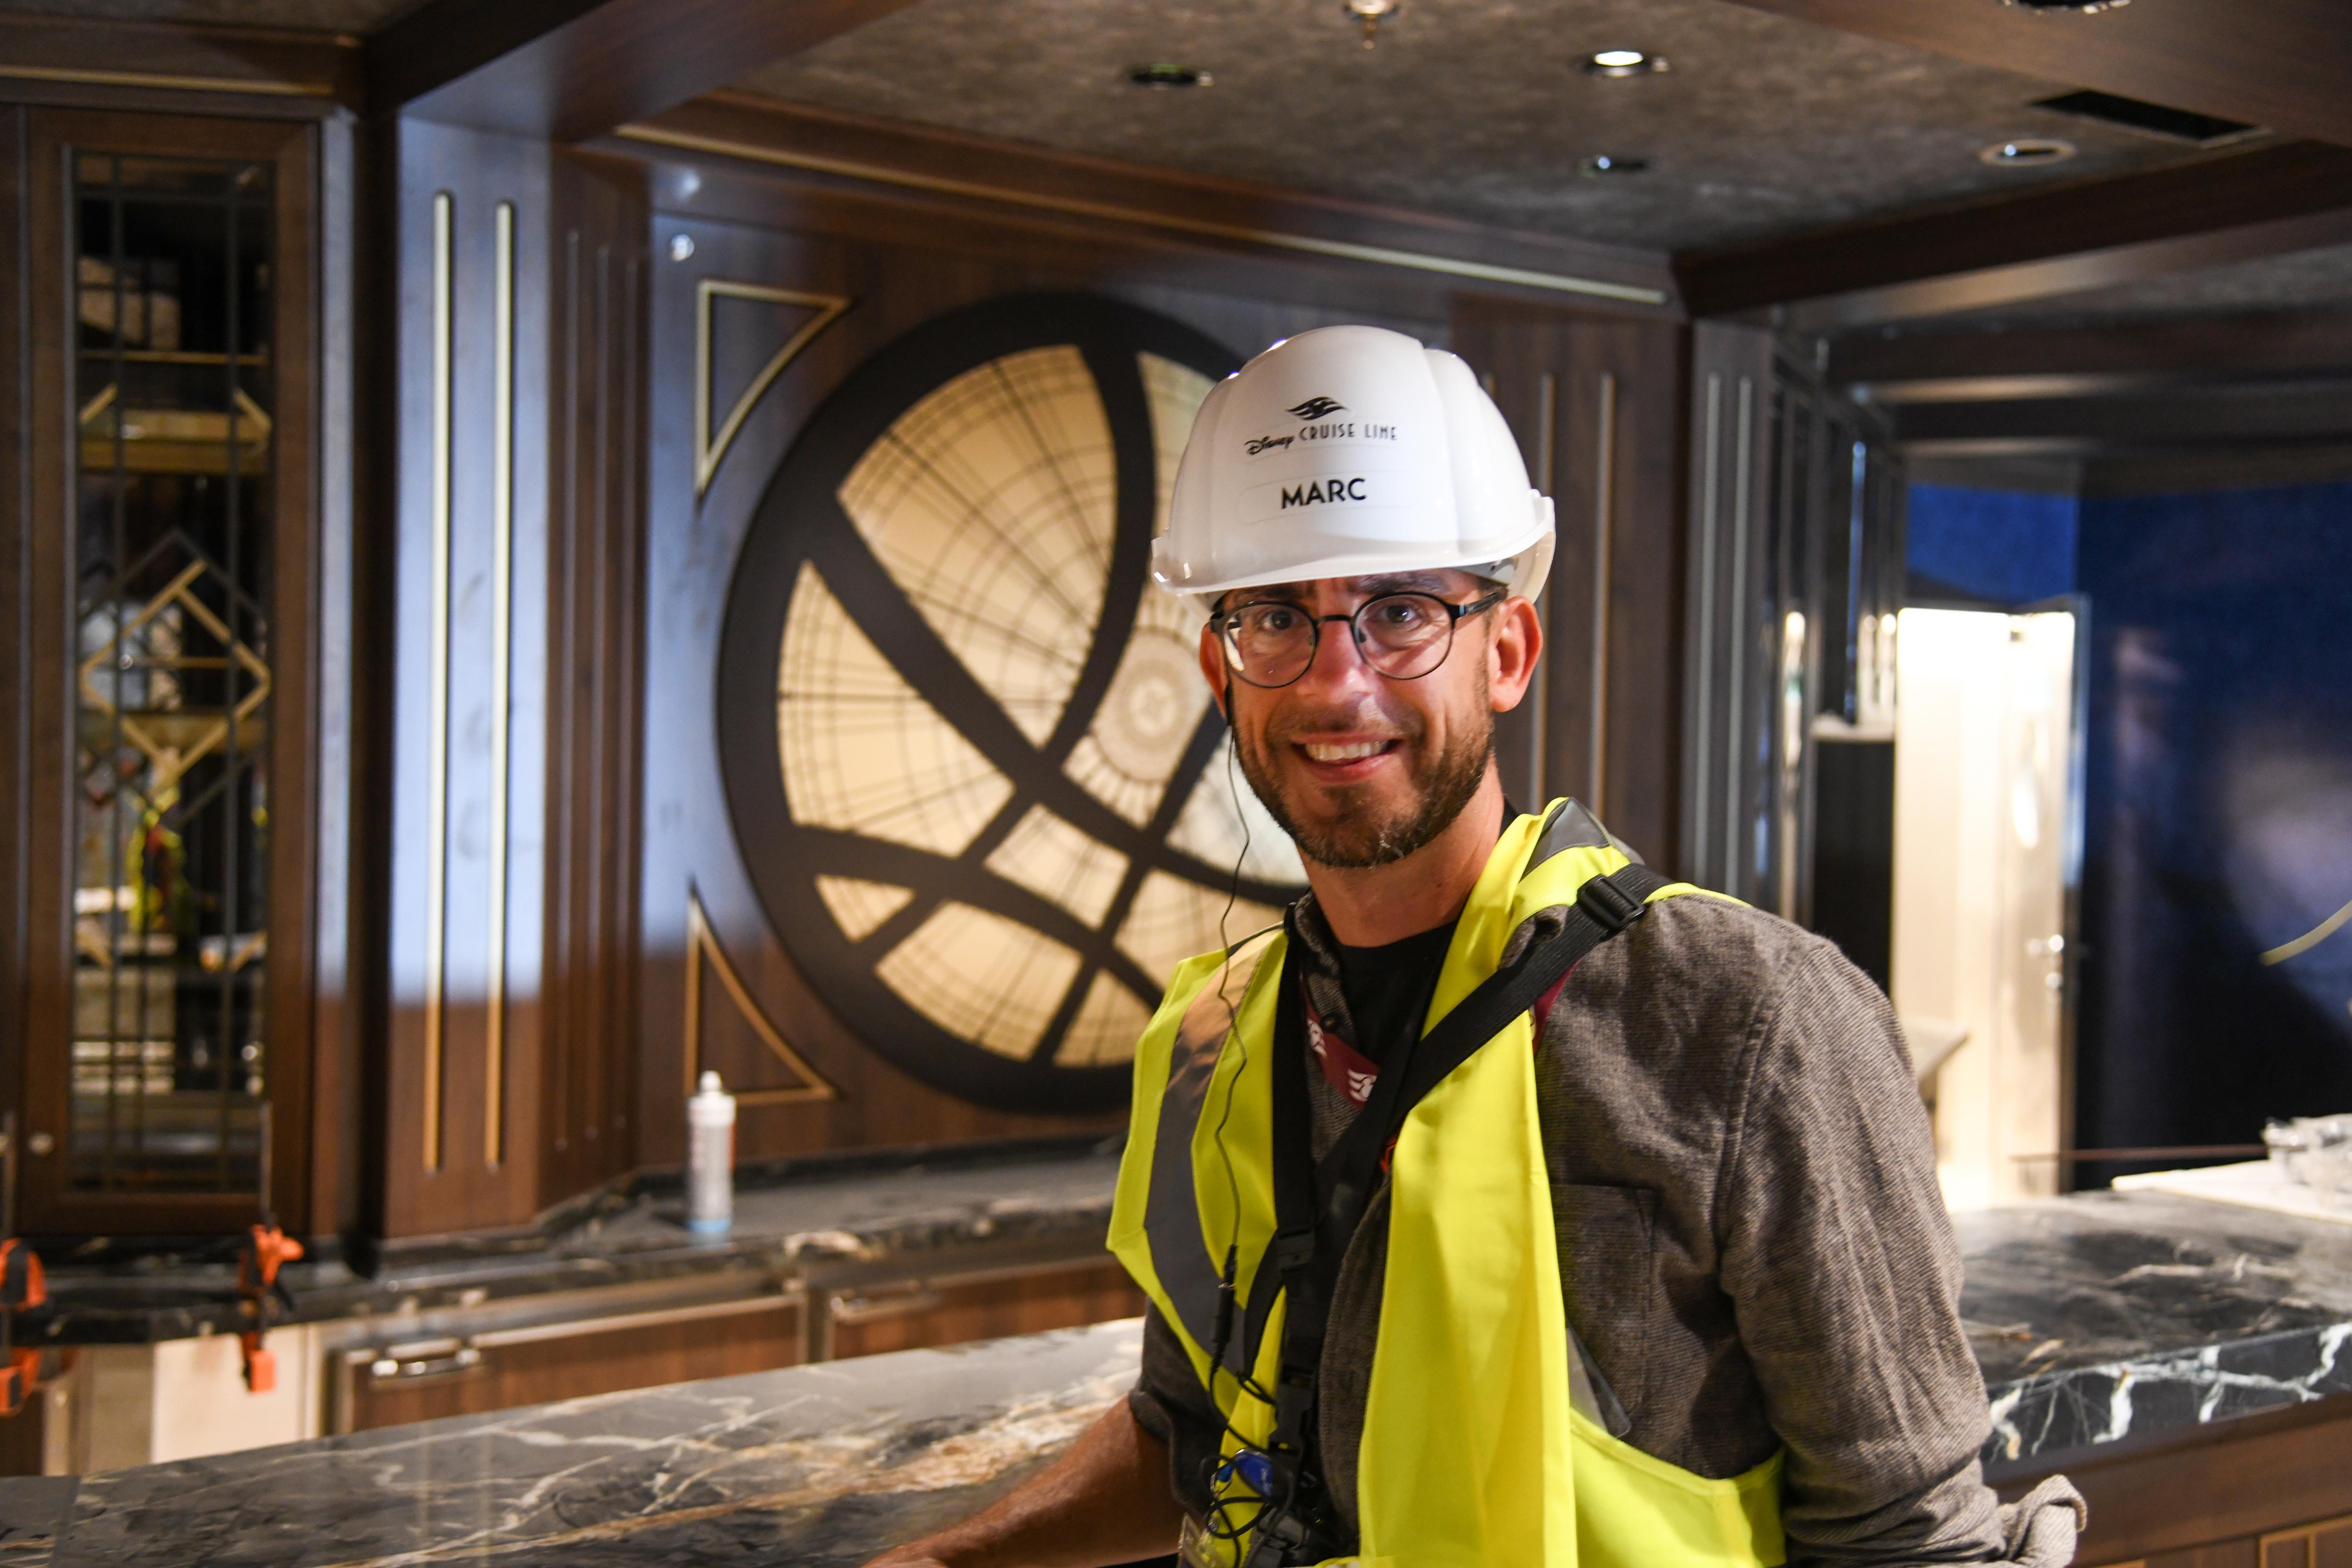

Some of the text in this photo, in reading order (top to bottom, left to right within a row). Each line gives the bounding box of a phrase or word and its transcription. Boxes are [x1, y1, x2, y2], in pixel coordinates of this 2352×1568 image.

[1244, 424, 1397, 455] Disney CRUISE LINE
[1281, 478, 1366, 509] MARC
